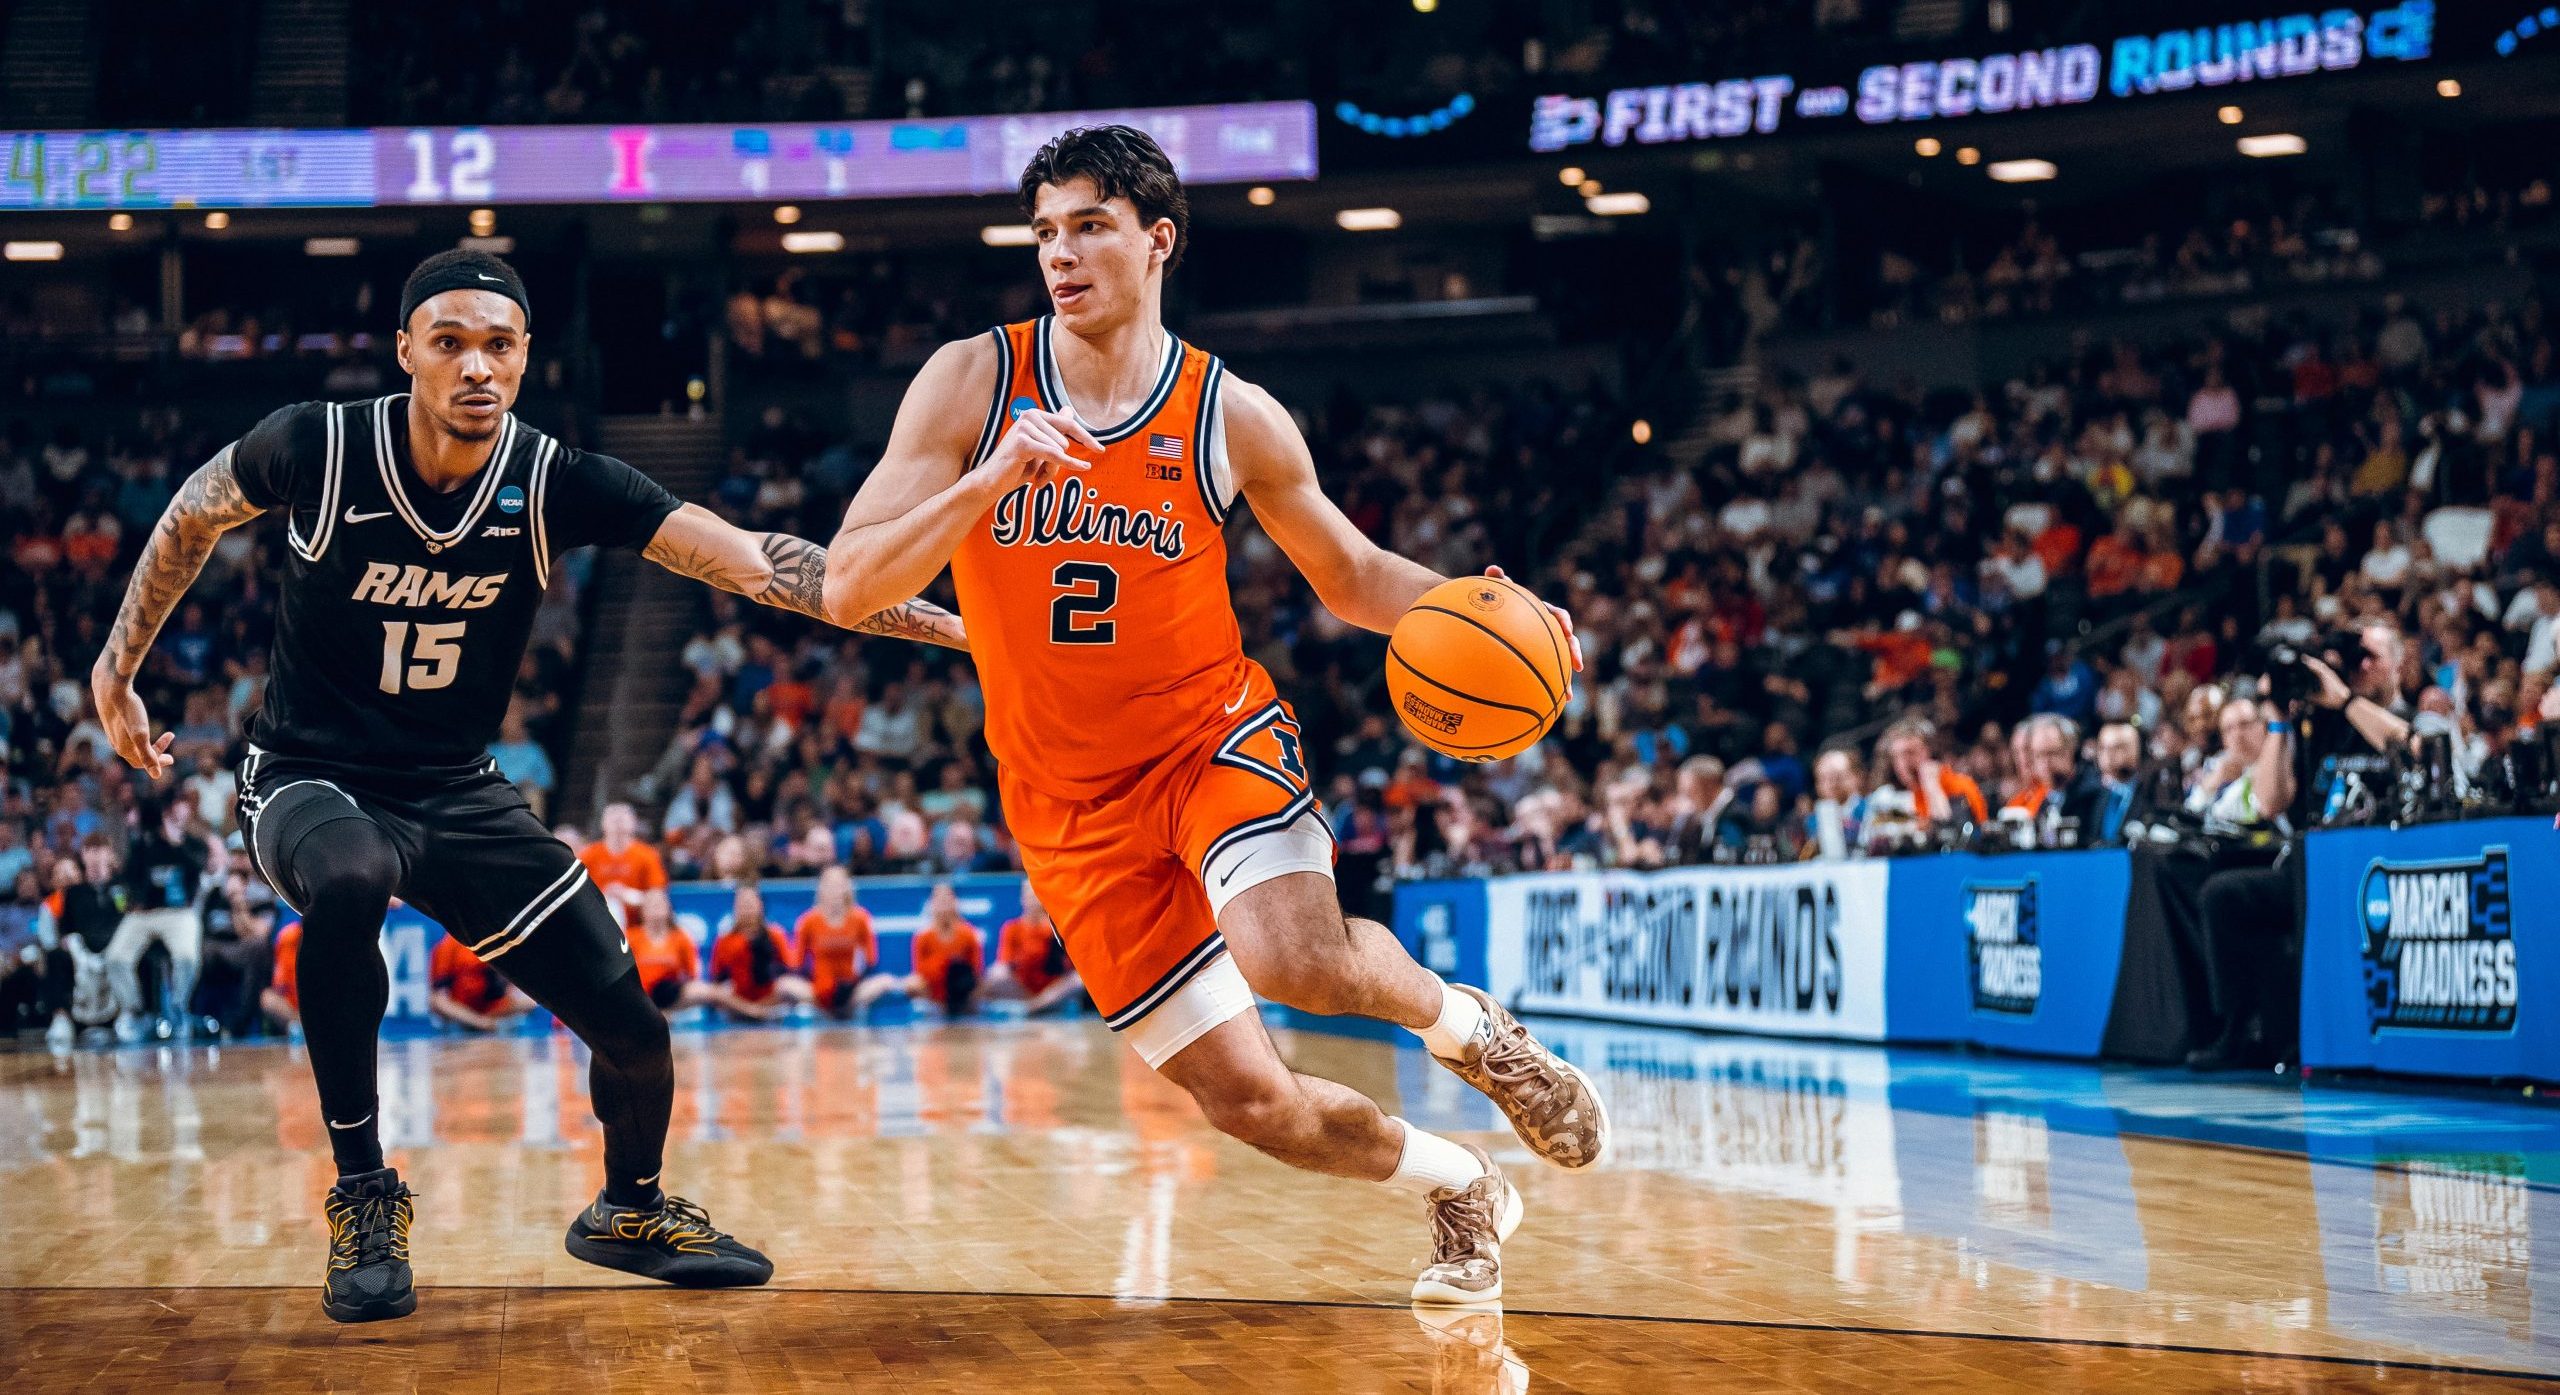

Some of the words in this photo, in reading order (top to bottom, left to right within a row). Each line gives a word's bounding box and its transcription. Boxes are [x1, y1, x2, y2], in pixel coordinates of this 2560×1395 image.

[1603, 75, 1794, 147] FIRST
[1856, 43, 2100, 124] SECOND
[2109, 8, 2364, 98] ROUNDS
[406, 130, 497, 200] 12
[500, 498, 523, 506] NCAA
[991, 476, 1185, 560] Illinois
[351, 561, 508, 609] RAMS
[1050, 560, 1119, 644] 2
[379, 620, 467, 694] 15
[1405, 693, 1444, 722] MADNESS
[1416, 712, 1447, 731] MARCH
[1268, 726, 1305, 784] I
[2388, 871, 2469, 939] MARCH
[2399, 938, 2518, 1007] MADNESS
